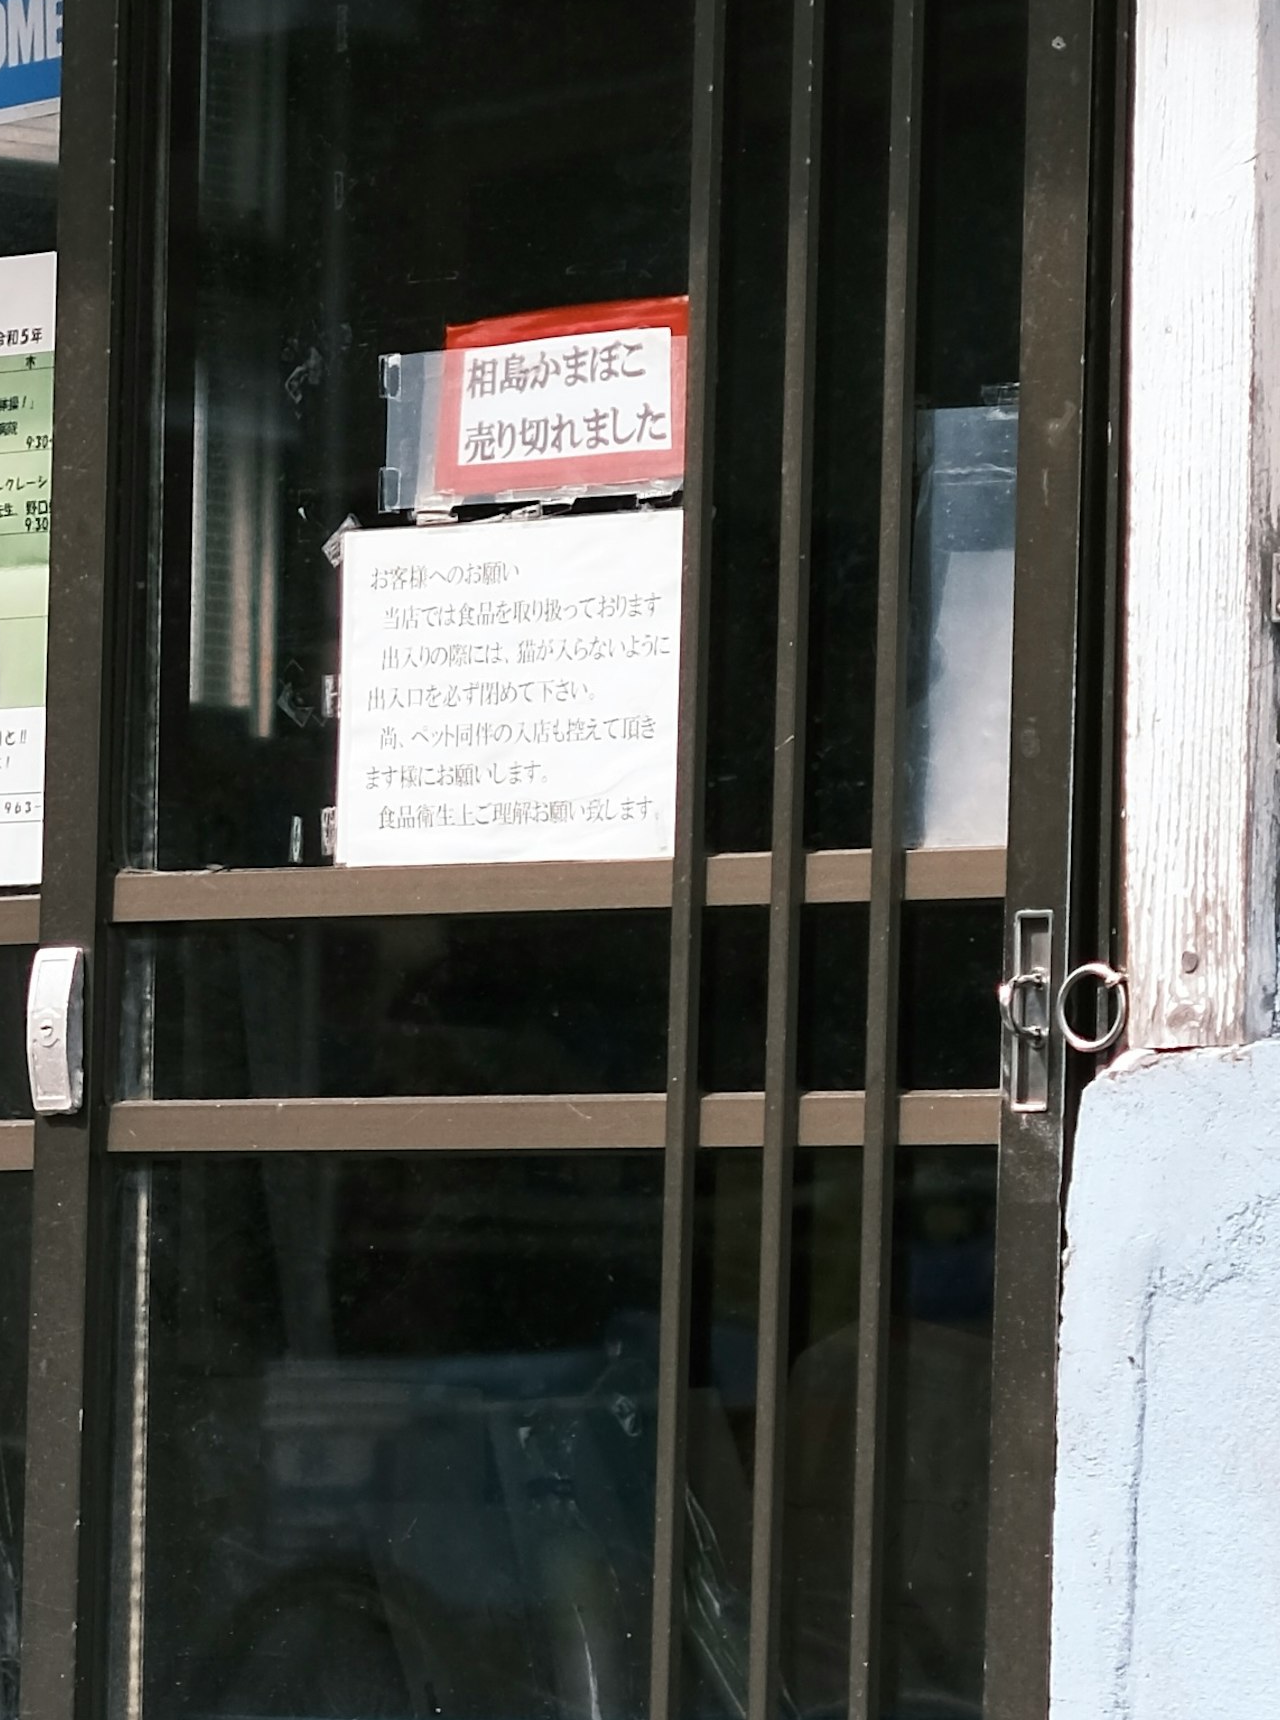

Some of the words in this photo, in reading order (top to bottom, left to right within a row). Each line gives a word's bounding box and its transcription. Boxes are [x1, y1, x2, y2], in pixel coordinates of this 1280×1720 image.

[25, 355, 36, 370] 木
[467, 340, 646, 399] 相島かまぼこ
[465, 402, 668, 462] 売り切れました
[370, 561, 520, 591] お客様へのお願い
[382, 593, 662, 630] 当店では食品を取り扱っております
[380, 632, 671, 671] 出入りの際には、猫が入らないように
[368, 679, 597, 711] 出入口を必ず閉めて下さい。
[379, 717, 656, 752] 尚、ペット同伴の入店も控えて頂き
[365, 760, 549, 791] ます様にお願いします。
[377, 796, 660, 830] 食品衛生上ご理解お願い致します。
